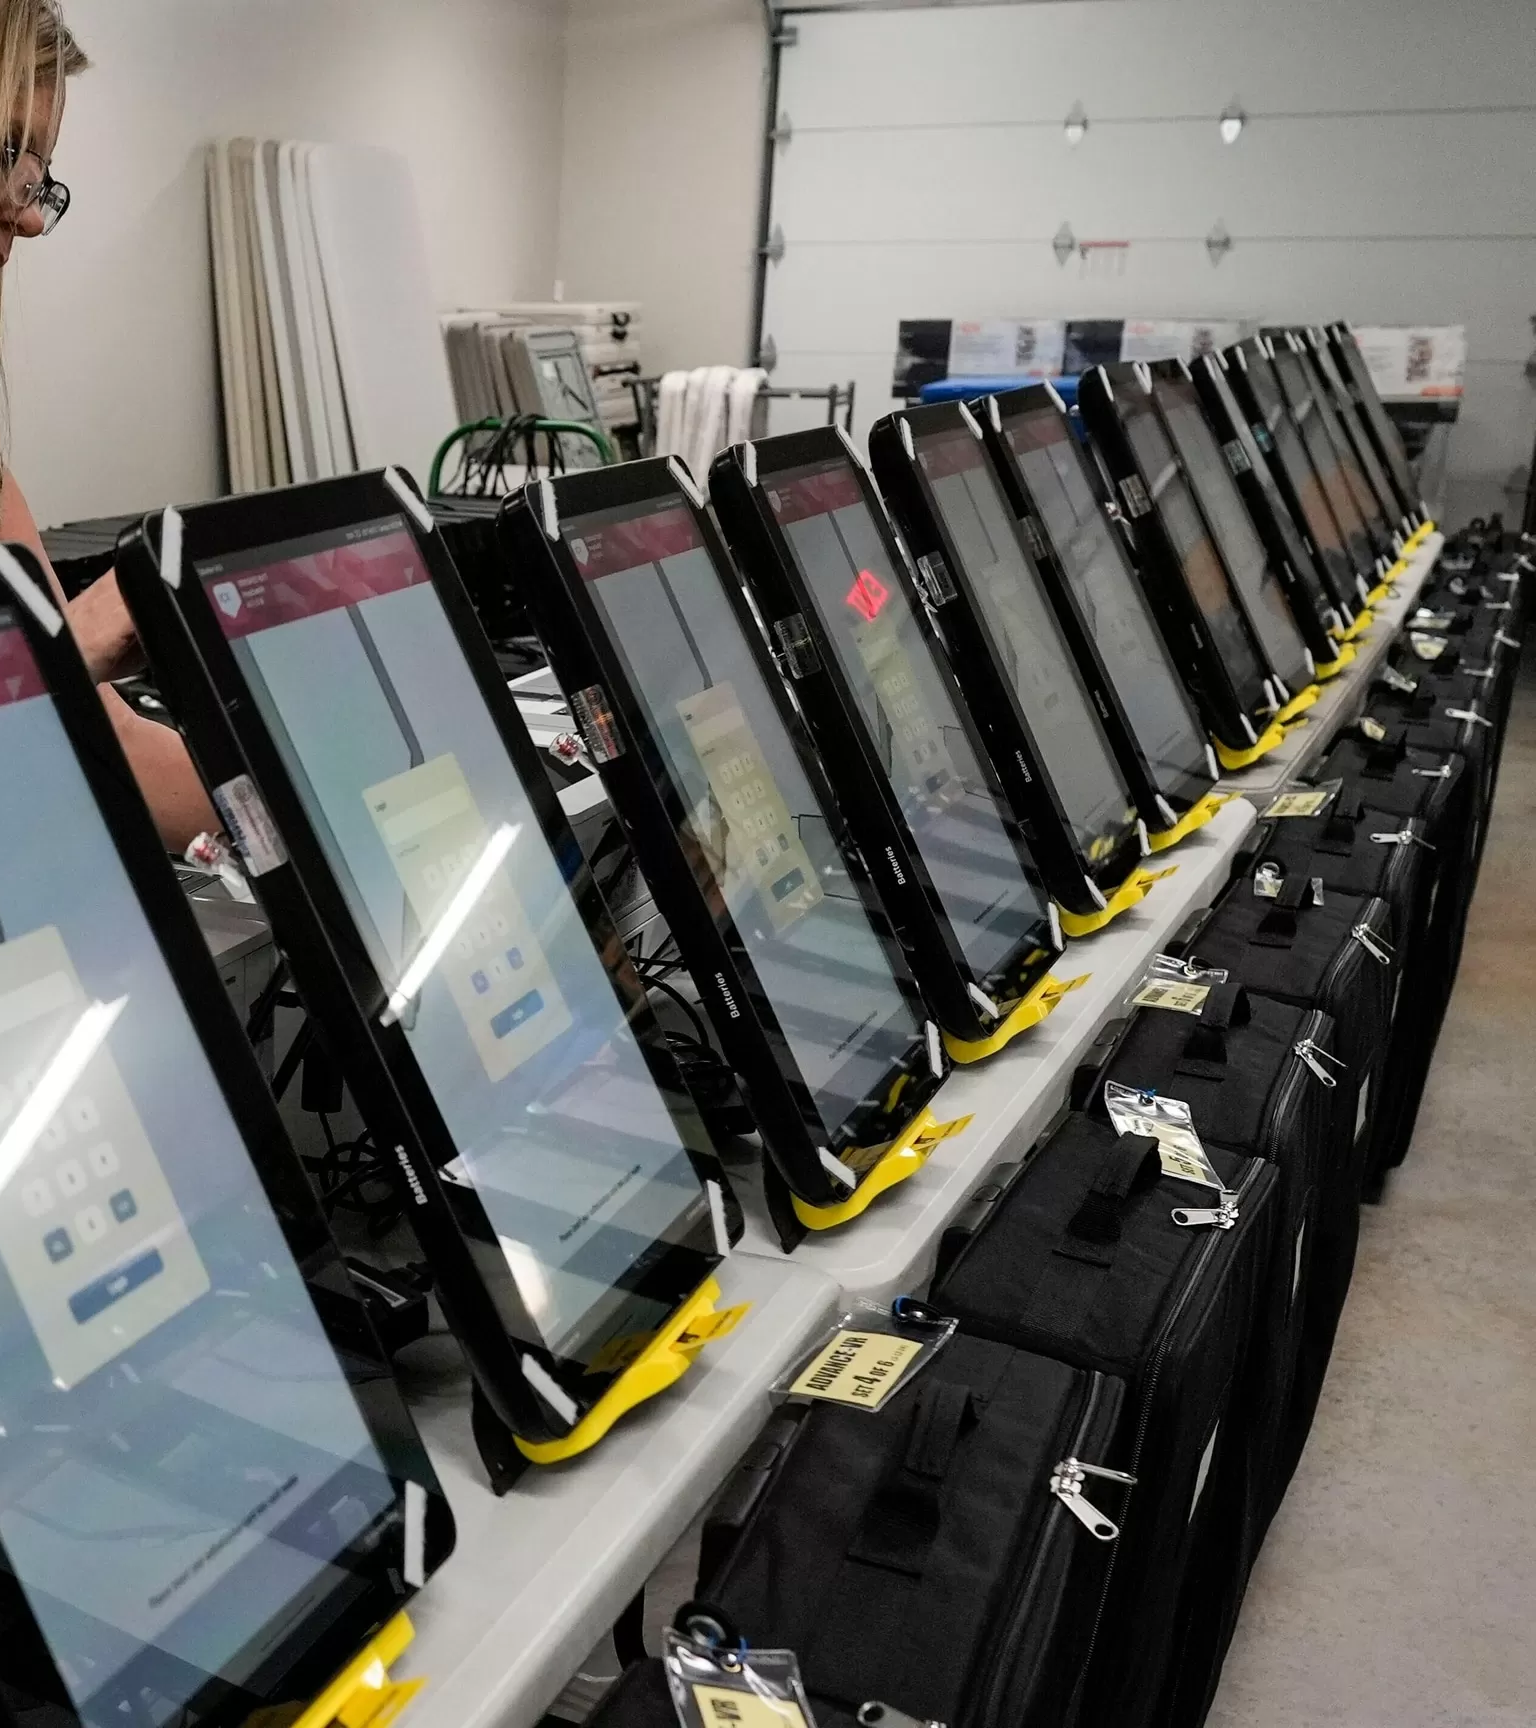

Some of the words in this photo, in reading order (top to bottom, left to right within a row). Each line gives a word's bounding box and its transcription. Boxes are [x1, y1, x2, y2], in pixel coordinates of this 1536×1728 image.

[885, 846, 906, 885] Batteries
[714, 972, 741, 1019] Batteries
[806, 1336, 869, 1391] ADVANCE-VR
[877, 1359, 895, 1367] 6
[869, 1366, 890, 1378] OF
[853, 1375, 882, 1386] 4
[851, 1385, 875, 1398] SET
